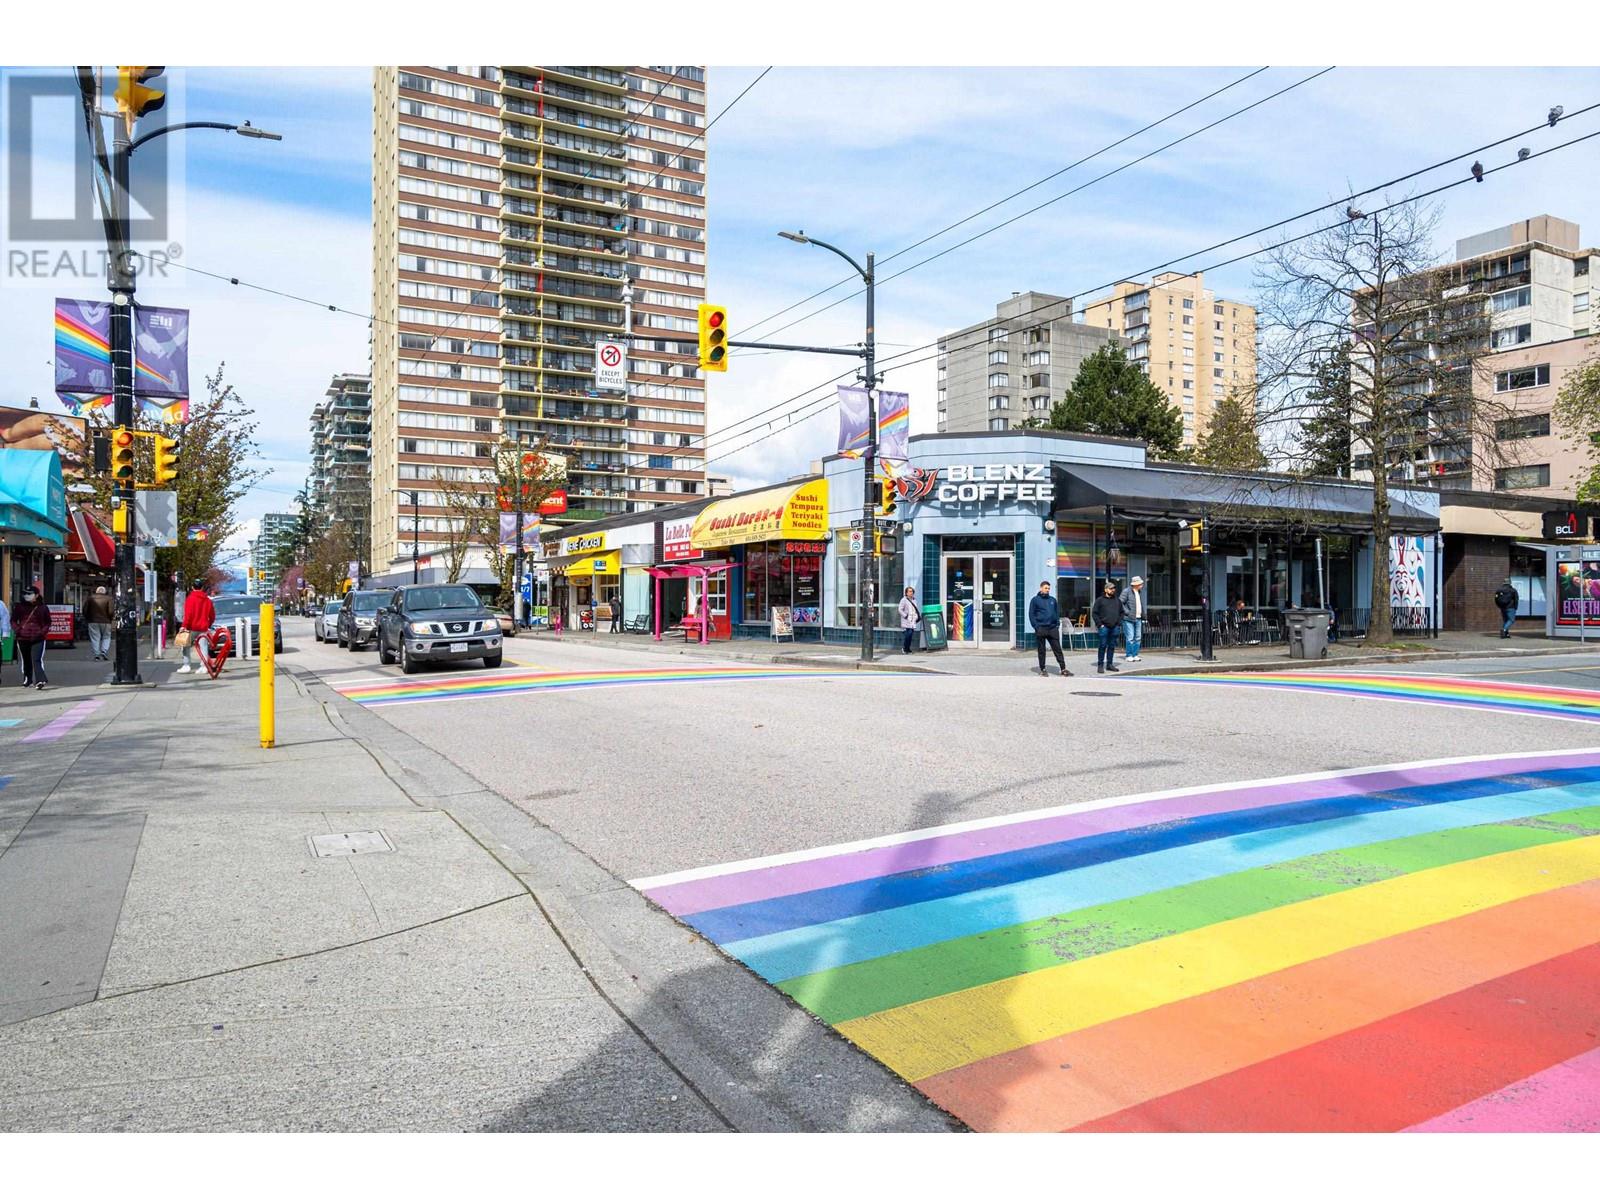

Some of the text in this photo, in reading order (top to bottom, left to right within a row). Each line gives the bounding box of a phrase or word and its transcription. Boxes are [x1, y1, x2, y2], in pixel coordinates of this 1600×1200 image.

[947, 463, 1046, 482] BLENZ
[938, 483, 1055, 502] COFFEE
[790, 502, 824, 511] Tempura
[791, 511, 823, 521] Teriyaki
[709, 513, 738, 531] Sushi
[792, 520, 822, 529] Noodles
[1556, 526, 1574, 534] BCL
